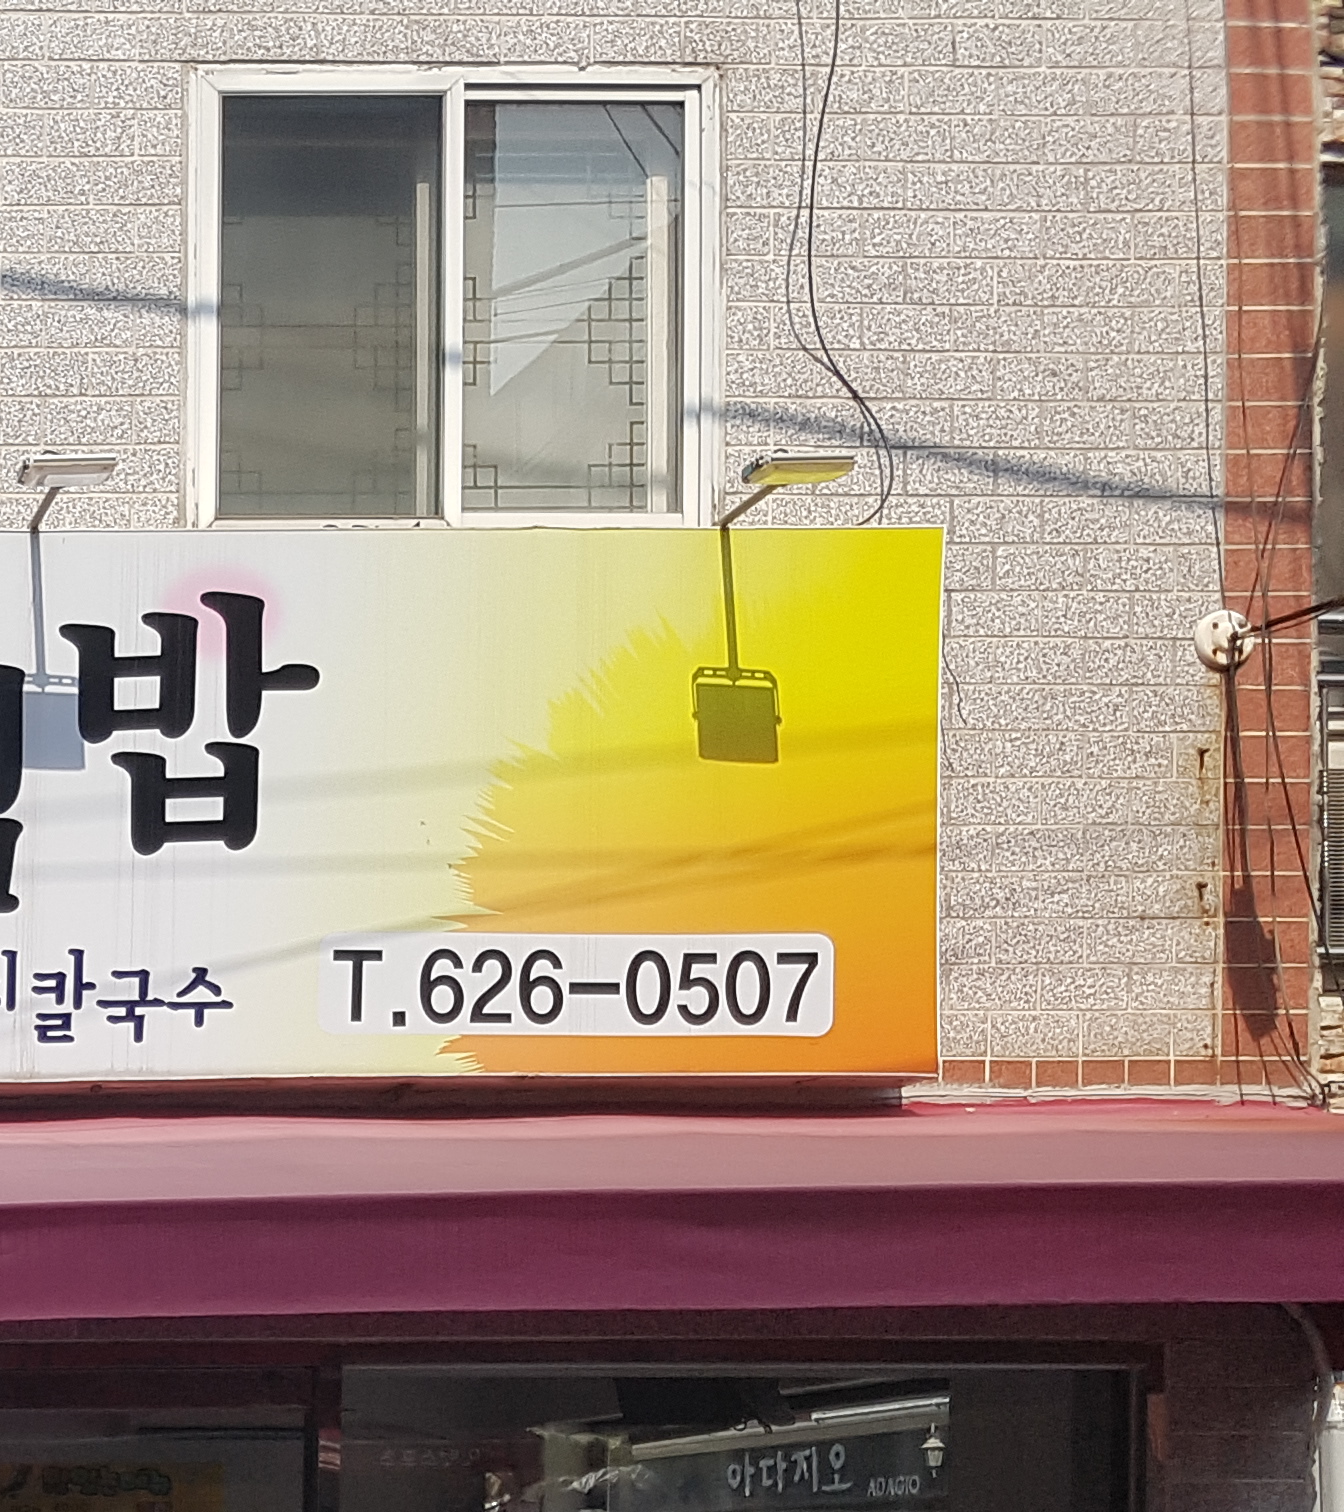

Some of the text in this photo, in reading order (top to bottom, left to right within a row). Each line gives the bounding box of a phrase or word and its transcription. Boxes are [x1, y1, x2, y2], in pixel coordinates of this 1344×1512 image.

[333, 948, 819, 1027] T.626-0507
[725, 1442, 855, 1498] 아다지오
[865, 1473, 921, 1498] ADAGIO
